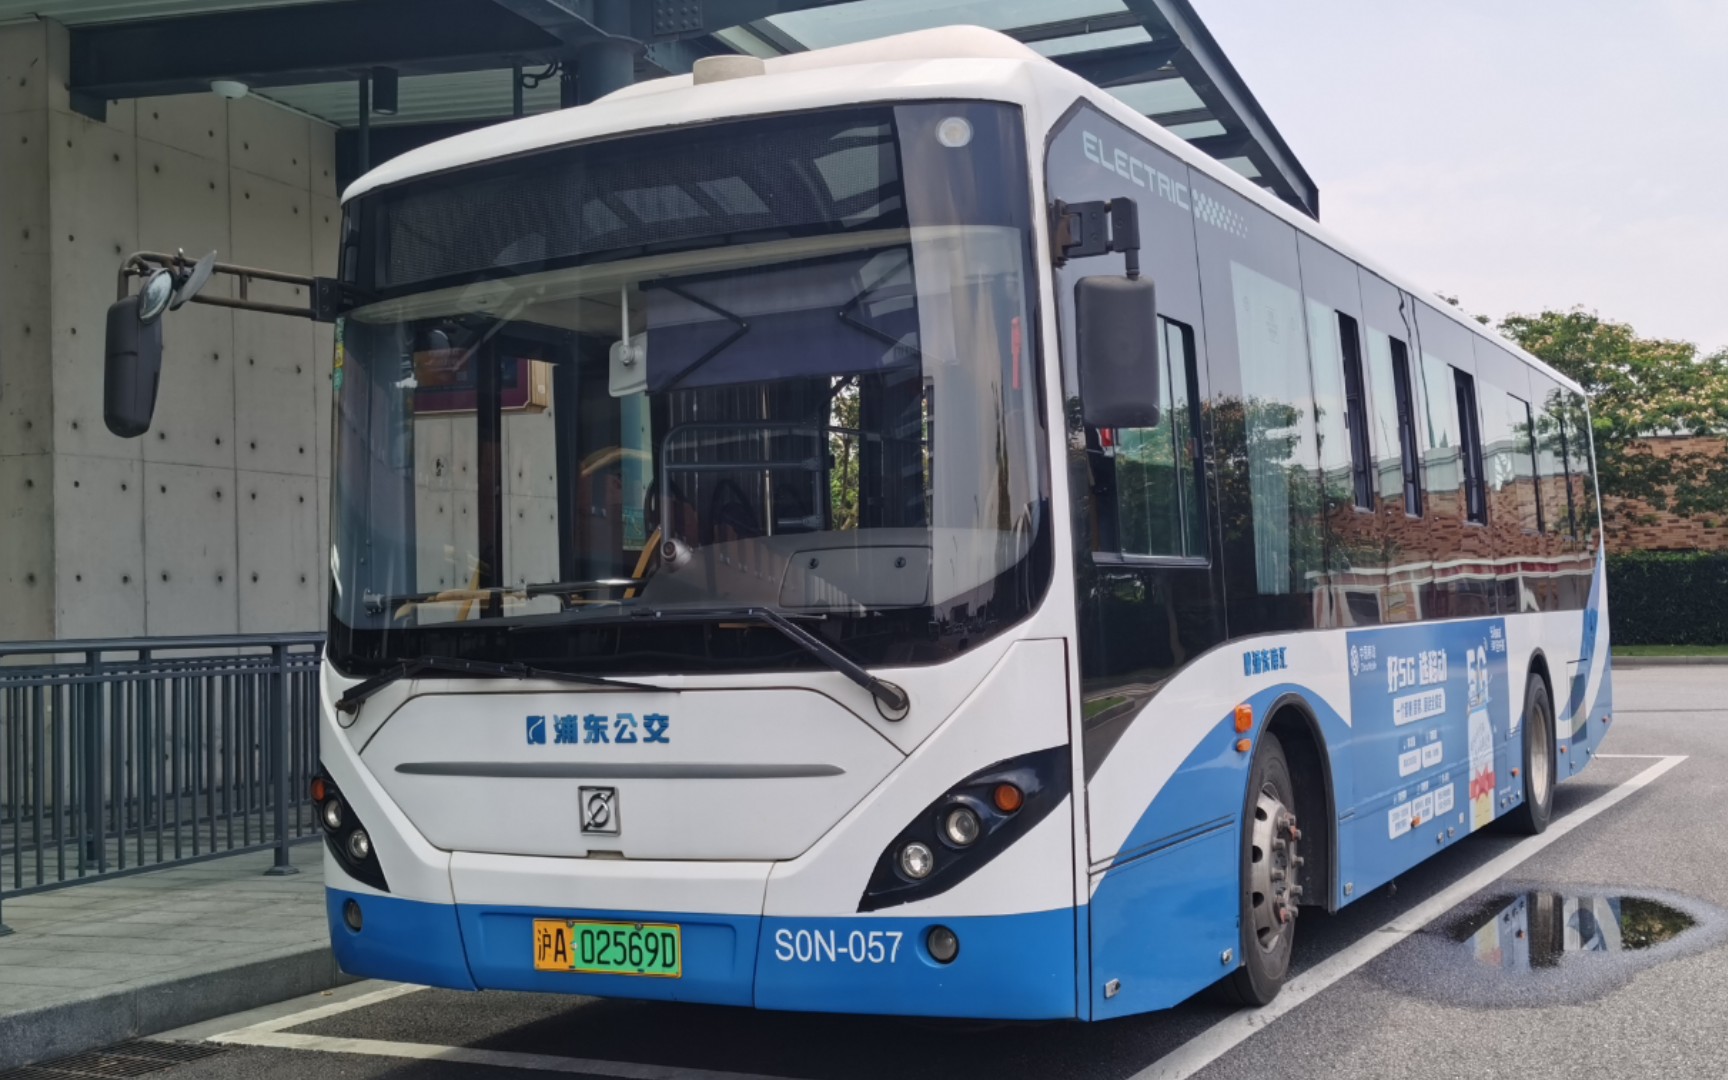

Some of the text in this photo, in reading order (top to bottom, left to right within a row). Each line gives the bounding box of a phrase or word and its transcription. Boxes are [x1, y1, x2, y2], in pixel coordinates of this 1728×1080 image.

[1082, 130, 1189, 210] ELECTRIC
[553, 713, 670, 744] 浦东公交
